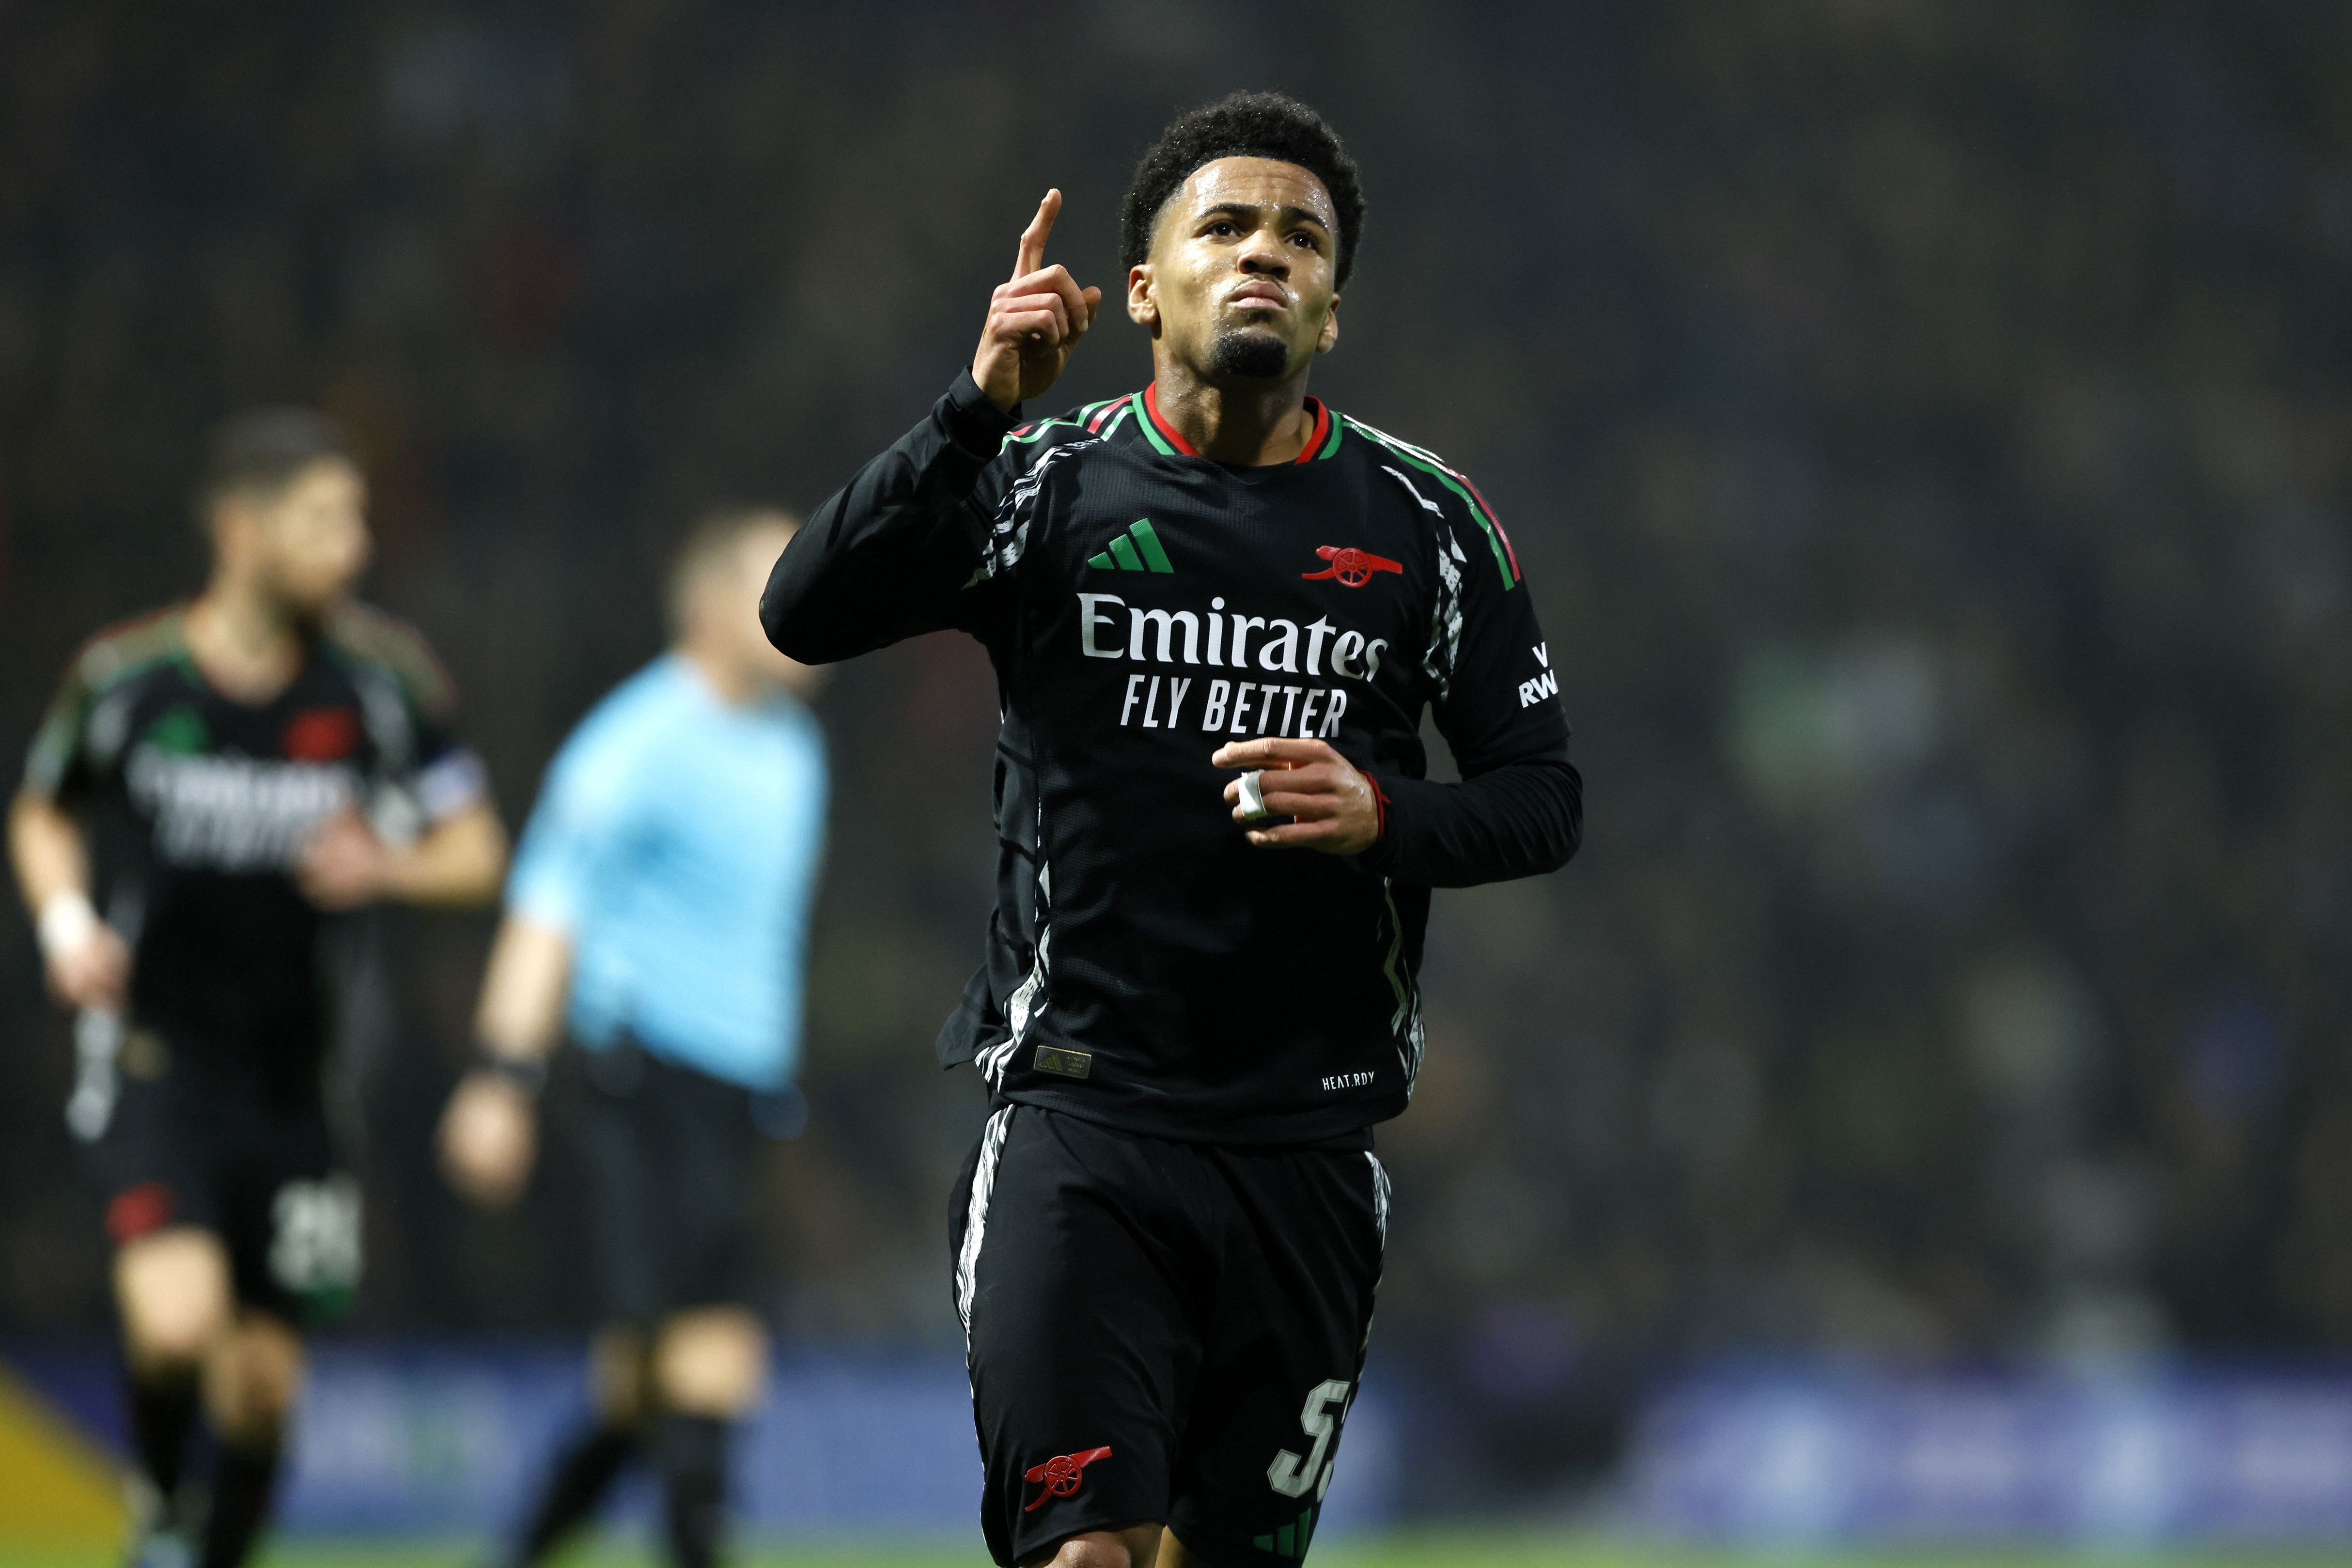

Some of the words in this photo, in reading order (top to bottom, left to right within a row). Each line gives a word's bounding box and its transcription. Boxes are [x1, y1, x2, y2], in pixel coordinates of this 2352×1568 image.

[1076, 593, 1388, 682] Emirates
[1120, 674, 1191, 729] FLY
[1202, 679, 1347, 737] BETTER
[1322, 1071, 1374, 1091] HEAT.RDY
